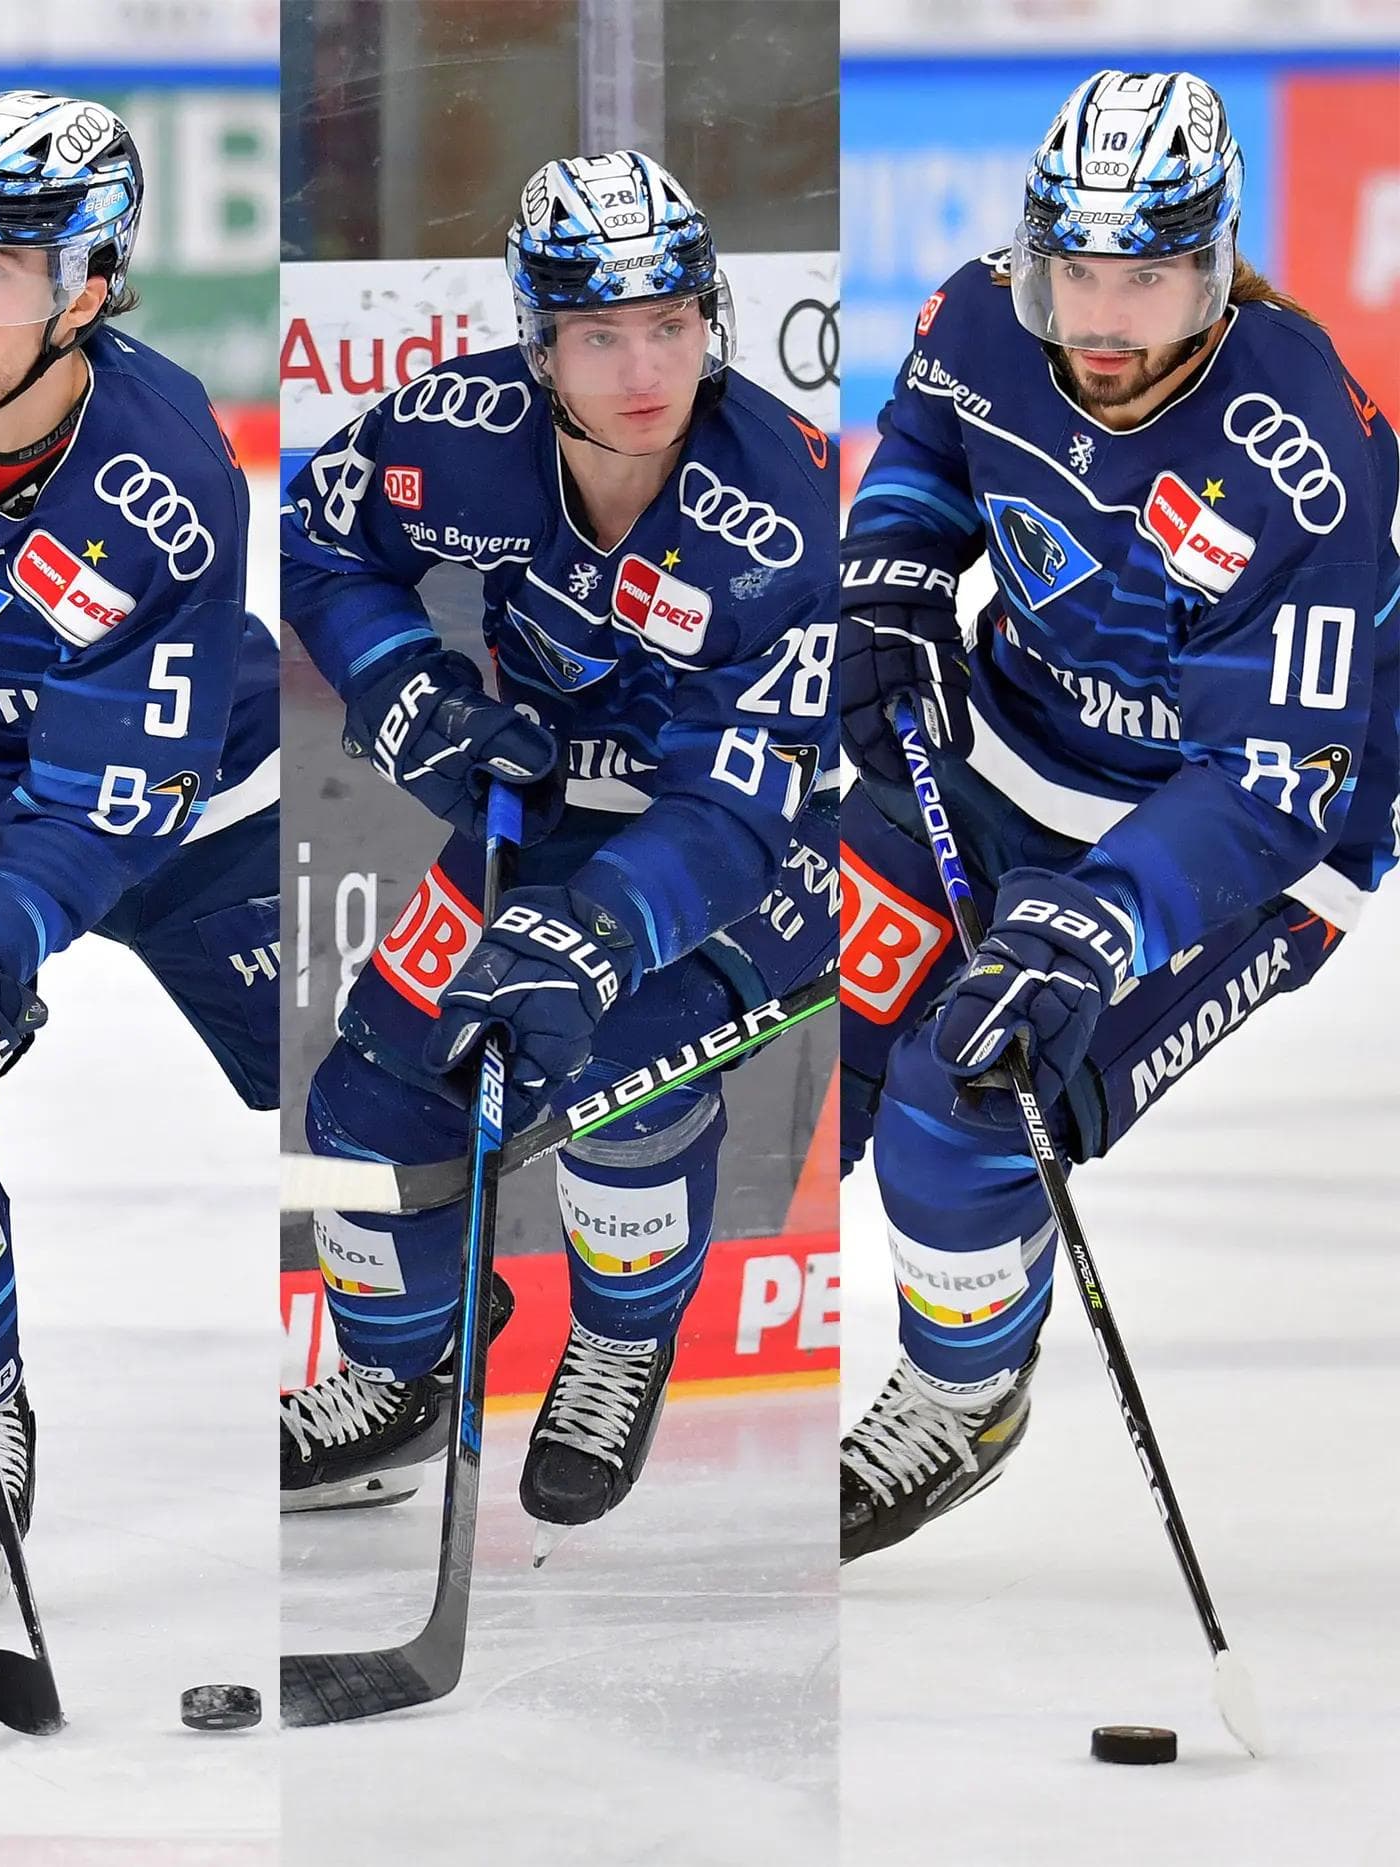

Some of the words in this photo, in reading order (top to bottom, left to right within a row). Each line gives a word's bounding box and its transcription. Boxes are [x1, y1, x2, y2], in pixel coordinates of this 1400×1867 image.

[1101, 132, 1128, 151] 10
[600, 190, 636, 209] 28
[1066, 210, 1136, 226] BAUER
[601, 253, 666, 274] BAUER
[280, 313, 470, 395] Audi
[444, 526, 531, 558] Bayern
[1187, 533, 1248, 576] DEL
[840, 559, 957, 598] UER
[67, 589, 126, 629] DEL
[653, 599, 704, 633] DEL
[736, 623, 838, 718] 28
[1270, 602, 1356, 710] 10
[143, 643, 195, 739] 5
[902, 729, 959, 863] VAPOR
[491, 905, 619, 1012] BAUE
[567, 999, 787, 1131] BAUER
[1018, 1091, 1054, 1162] BAUER
[1073, 1243, 1103, 1310] HYPERLITE
